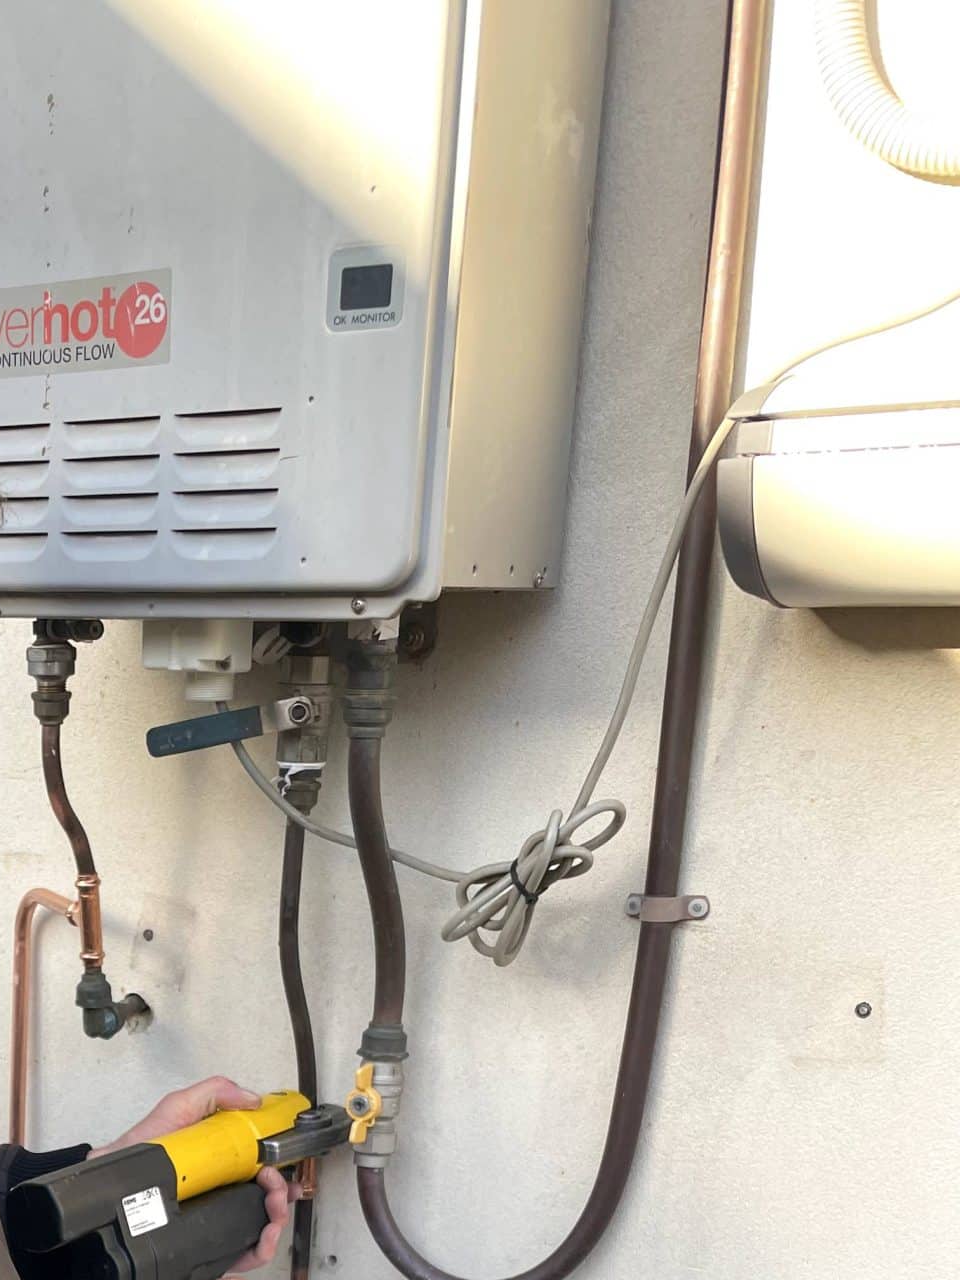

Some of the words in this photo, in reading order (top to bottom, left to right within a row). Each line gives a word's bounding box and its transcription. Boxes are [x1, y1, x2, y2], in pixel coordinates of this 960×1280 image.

[134, 293, 168, 326] 26
[333, 315, 347, 326] OK
[351, 311, 396, 325] MONITOR
[75, 342, 116, 362] FLOW
